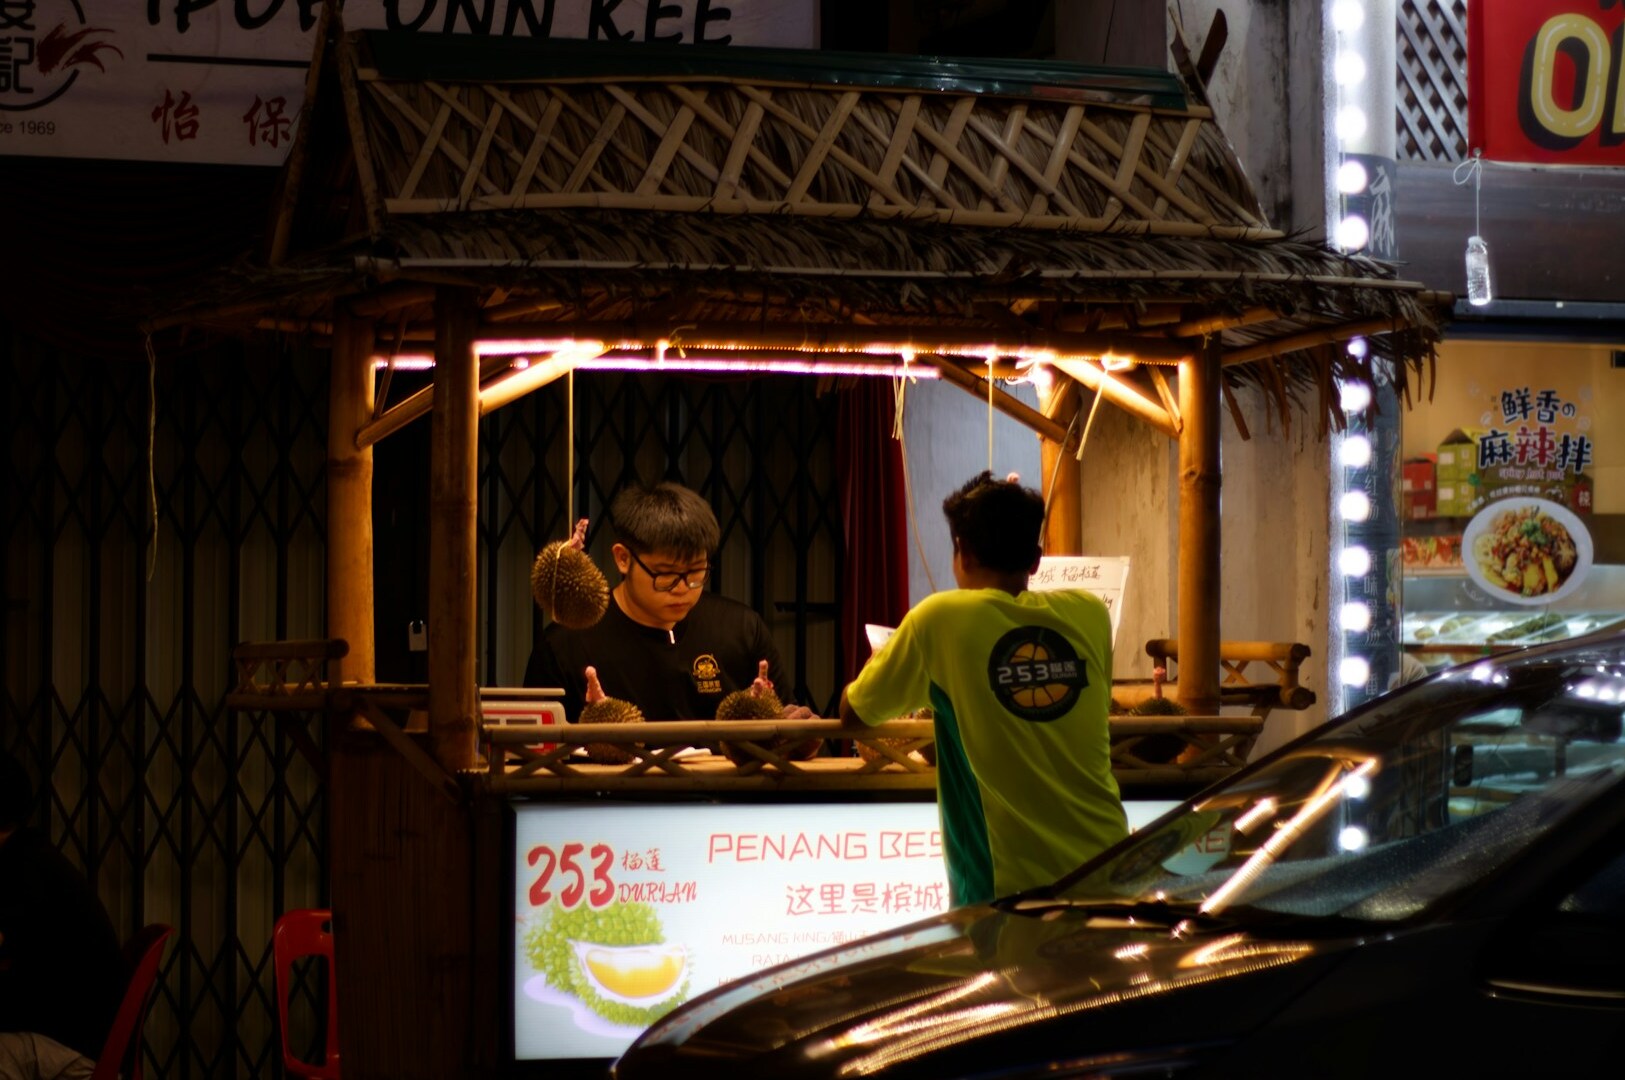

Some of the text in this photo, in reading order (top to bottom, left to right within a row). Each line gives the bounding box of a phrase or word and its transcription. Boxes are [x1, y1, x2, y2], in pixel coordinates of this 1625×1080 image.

[1531, 12, 1625, 138] O
[19, 120, 56, 135] 1969
[1480, 426, 1592, 472] 麻辣拌
[996, 663, 1050, 684] 253
[708, 831, 943, 863] PENANG BES
[527, 842, 615, 909] 253
[618, 881, 697, 904] DURIAN
[785, 882, 949, 916] 这里是槟城
[721, 931, 789, 945] MUSANG
